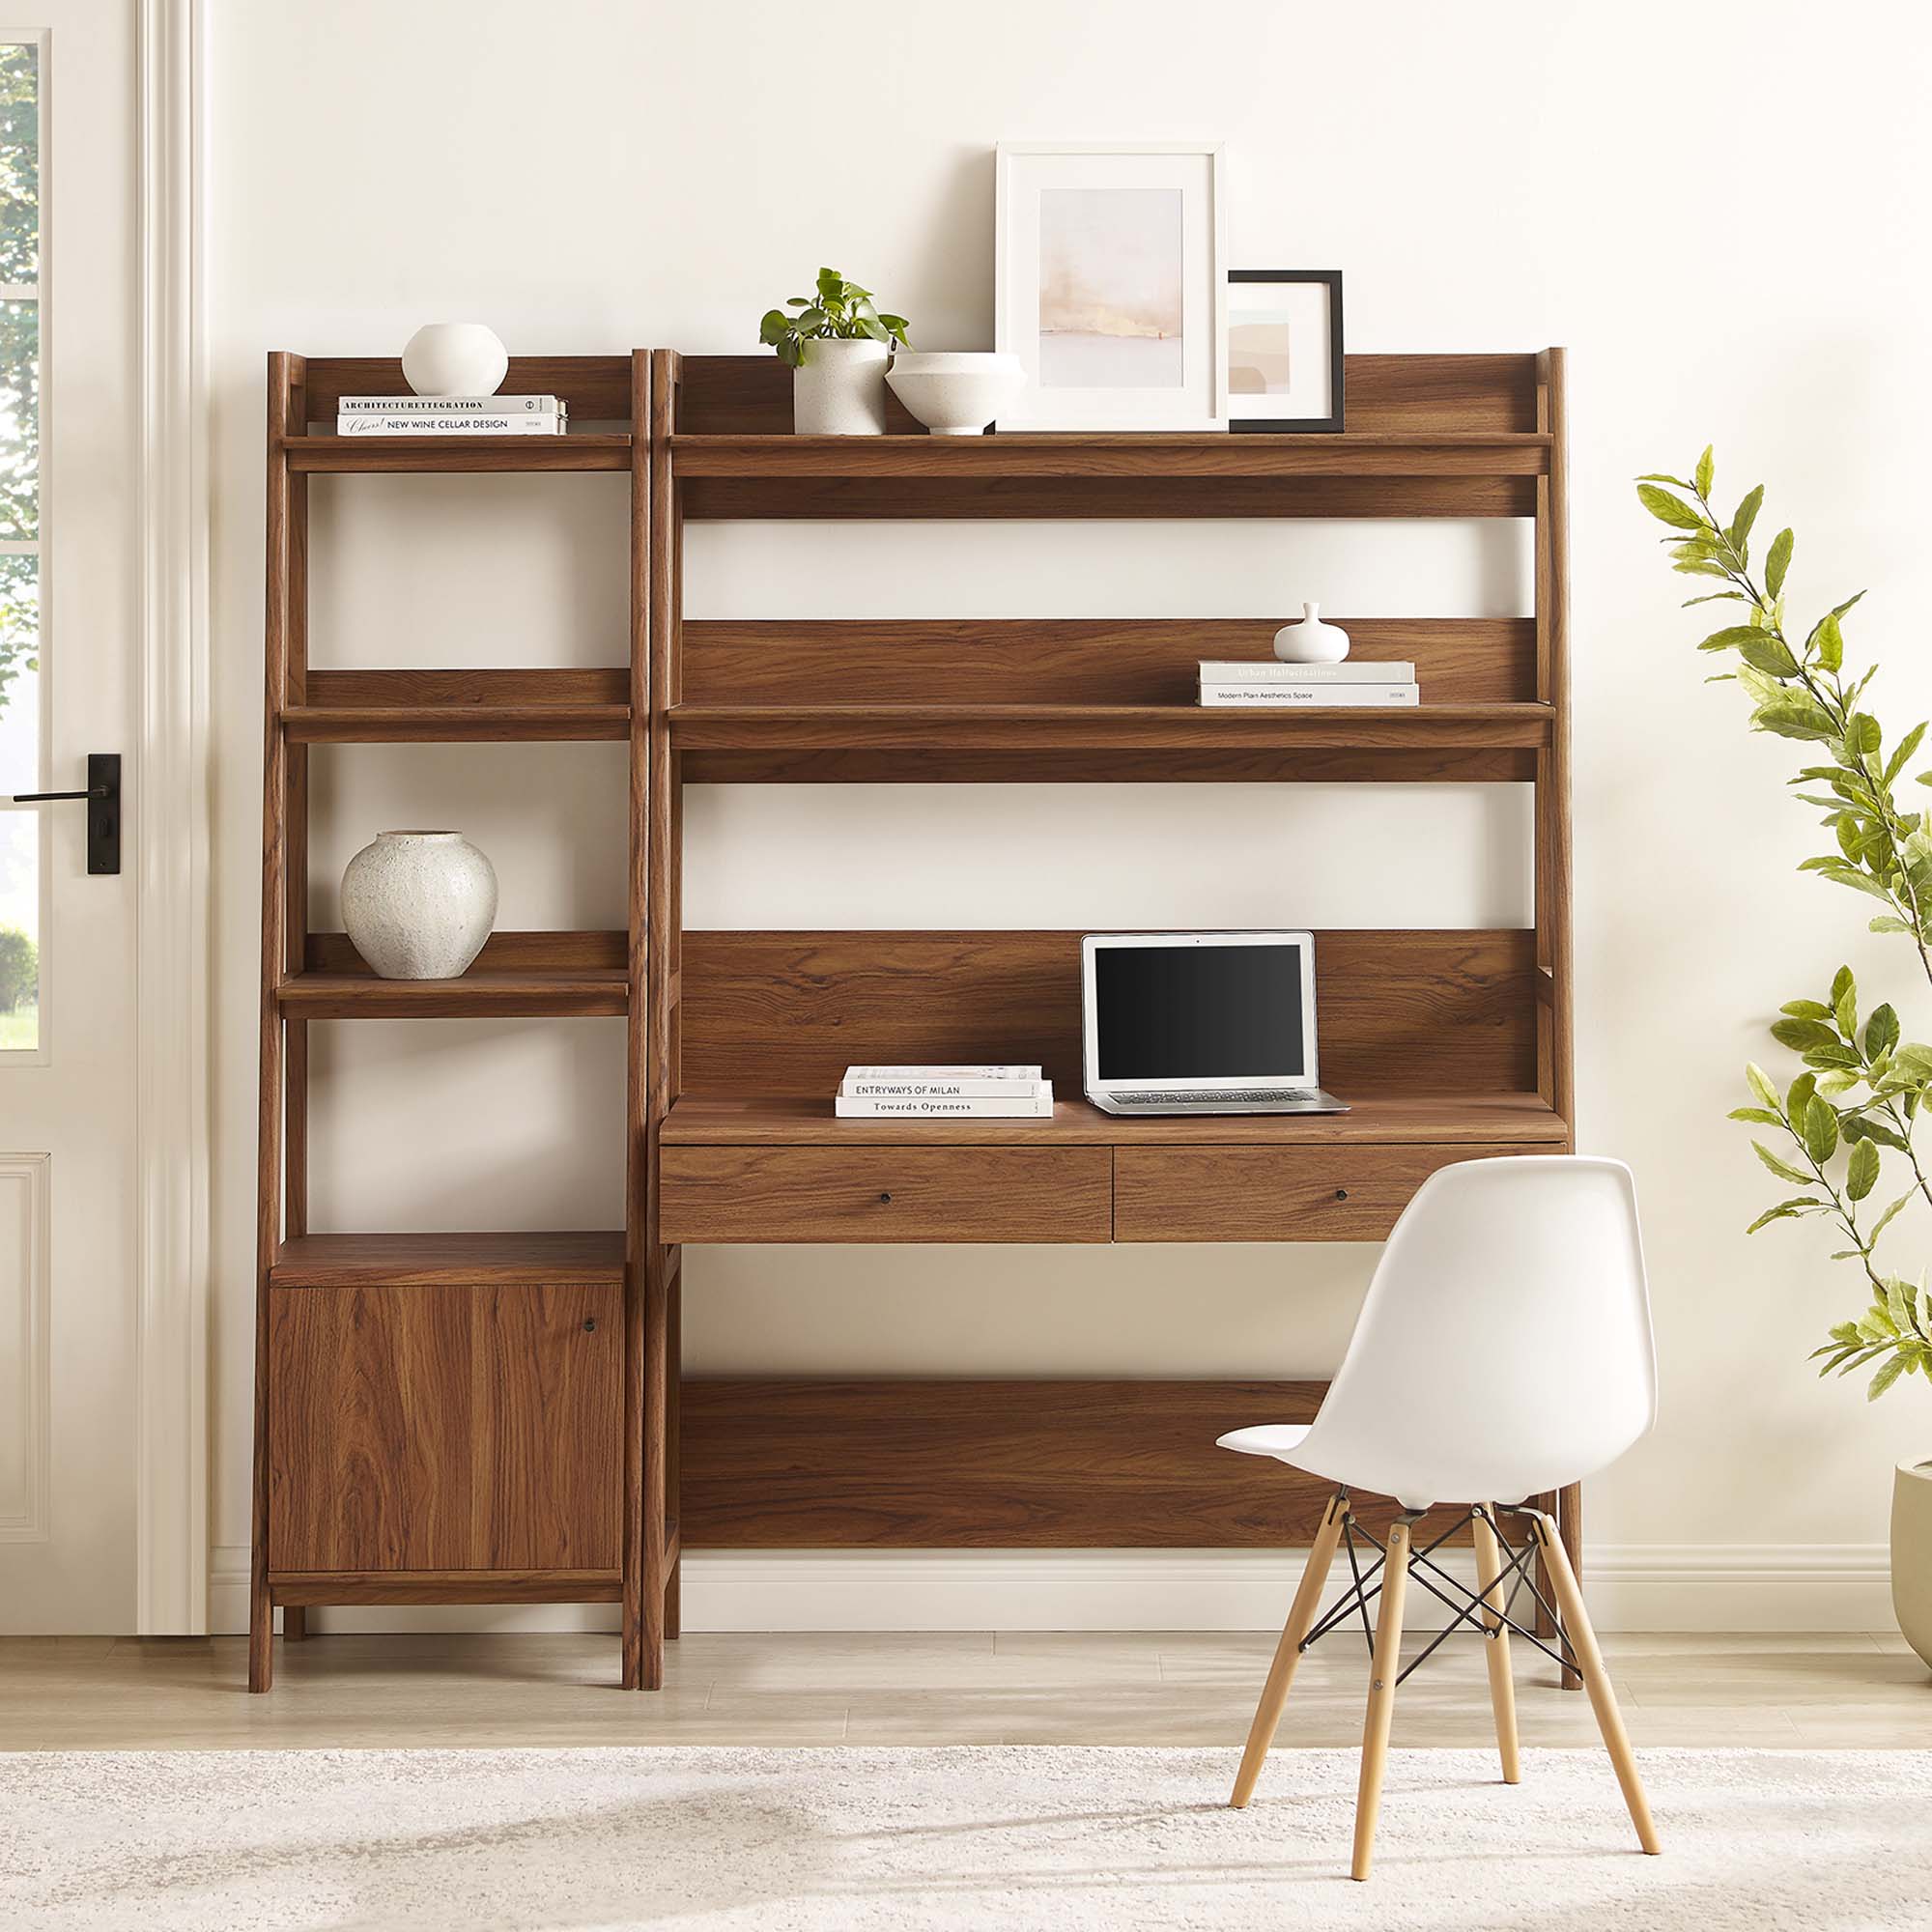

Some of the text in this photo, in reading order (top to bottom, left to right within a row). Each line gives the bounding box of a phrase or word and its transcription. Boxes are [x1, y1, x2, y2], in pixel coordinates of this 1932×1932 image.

[386, 420, 409, 429] NEW
[412, 420, 436, 429] WINE
[438, 419, 470, 429] CELLAR
[472, 419, 508, 429] DESIGN
[1293, 692, 1313, 701] Space
[856, 1085, 960, 1094] ENTRYWAYS OF MILAN
[874, 1102, 972, 1113] Towards Openness
